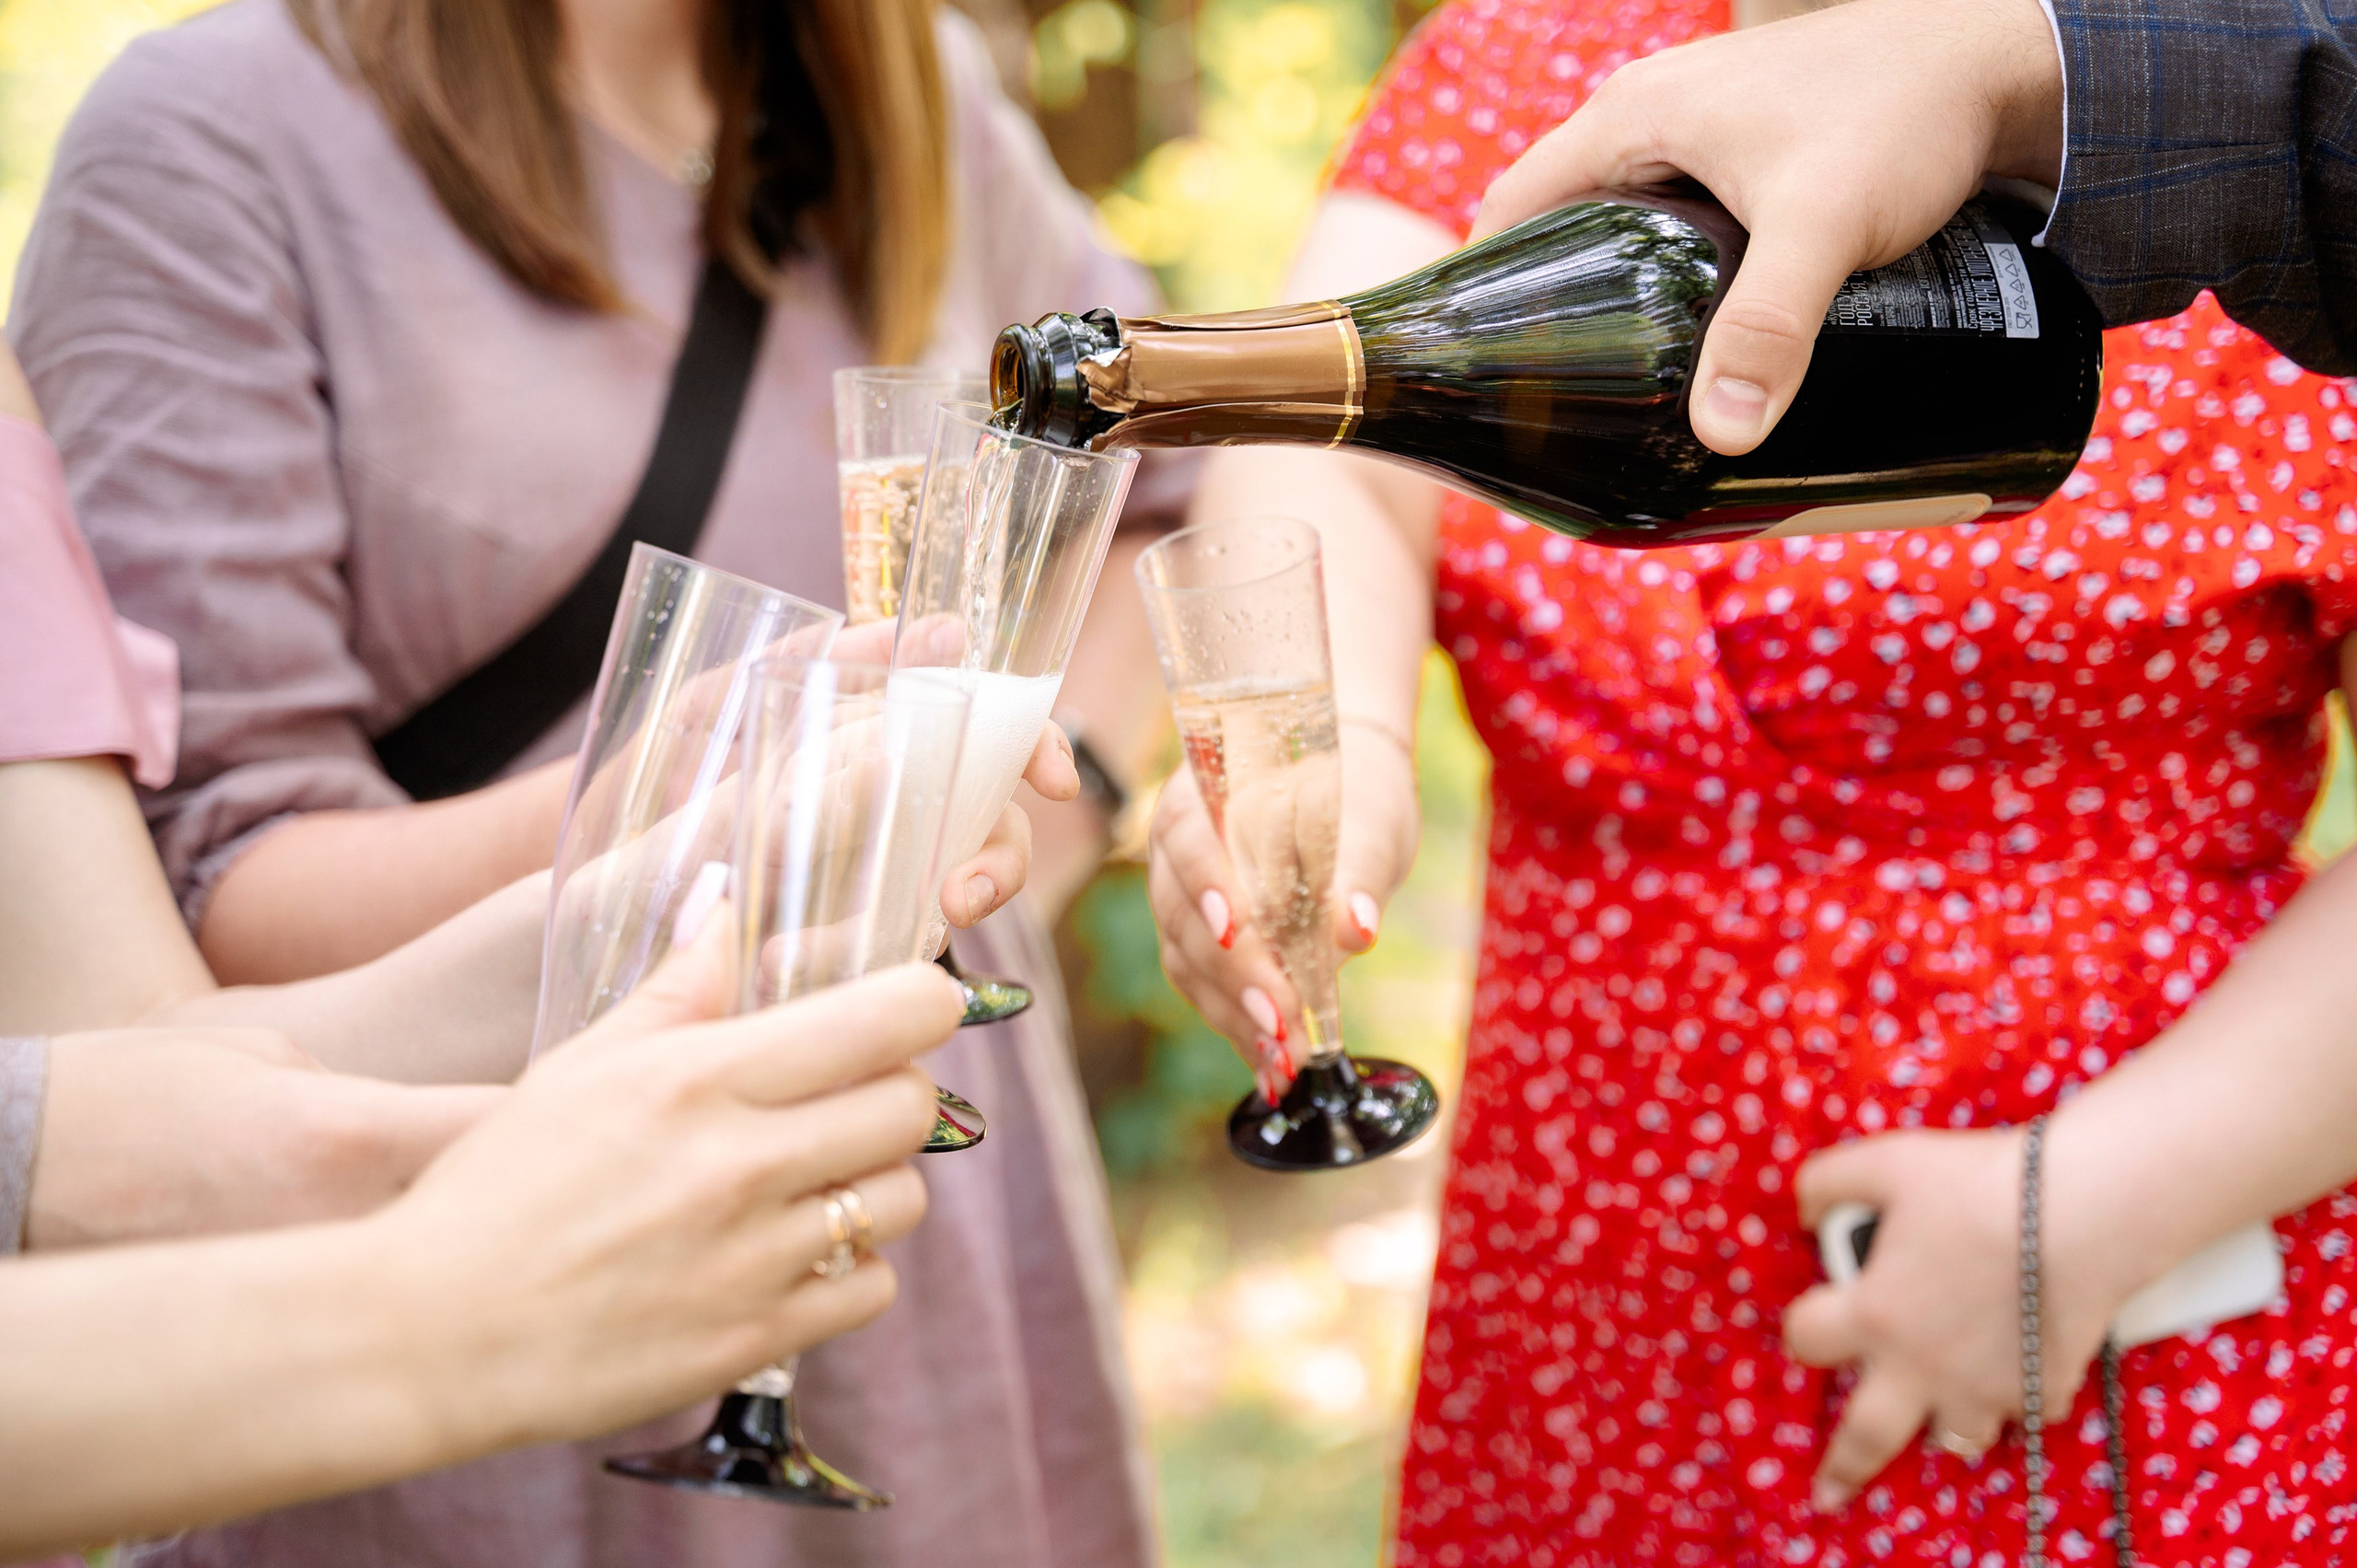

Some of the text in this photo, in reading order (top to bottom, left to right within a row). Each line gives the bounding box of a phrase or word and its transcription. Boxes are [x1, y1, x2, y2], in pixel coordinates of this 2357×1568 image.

[1838, 303, 1856, 327] ГОД
[1956, 257, 1980, 330] Срок годности не
[1970, 278, 2004, 331] ЧРЕЗМЕРНОЕ
